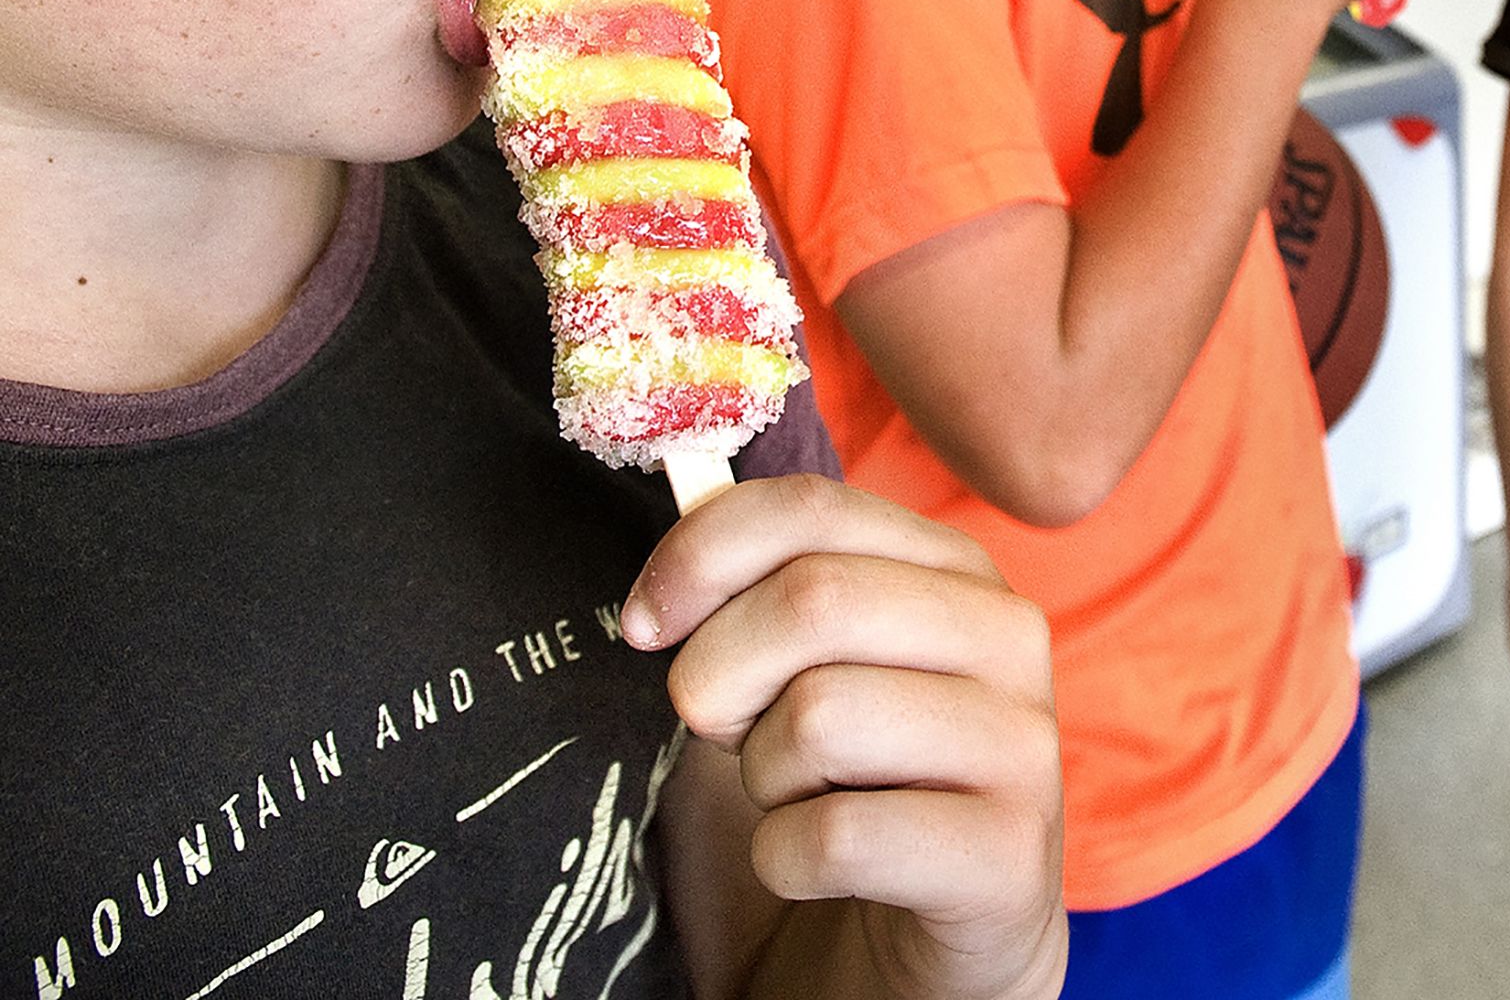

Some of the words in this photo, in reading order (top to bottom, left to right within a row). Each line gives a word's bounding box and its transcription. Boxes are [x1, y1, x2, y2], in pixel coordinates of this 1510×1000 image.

[34, 730, 342, 1000] MOUNTAIN
[376, 668, 474, 750] AND
[495, 619, 581, 682] THE
